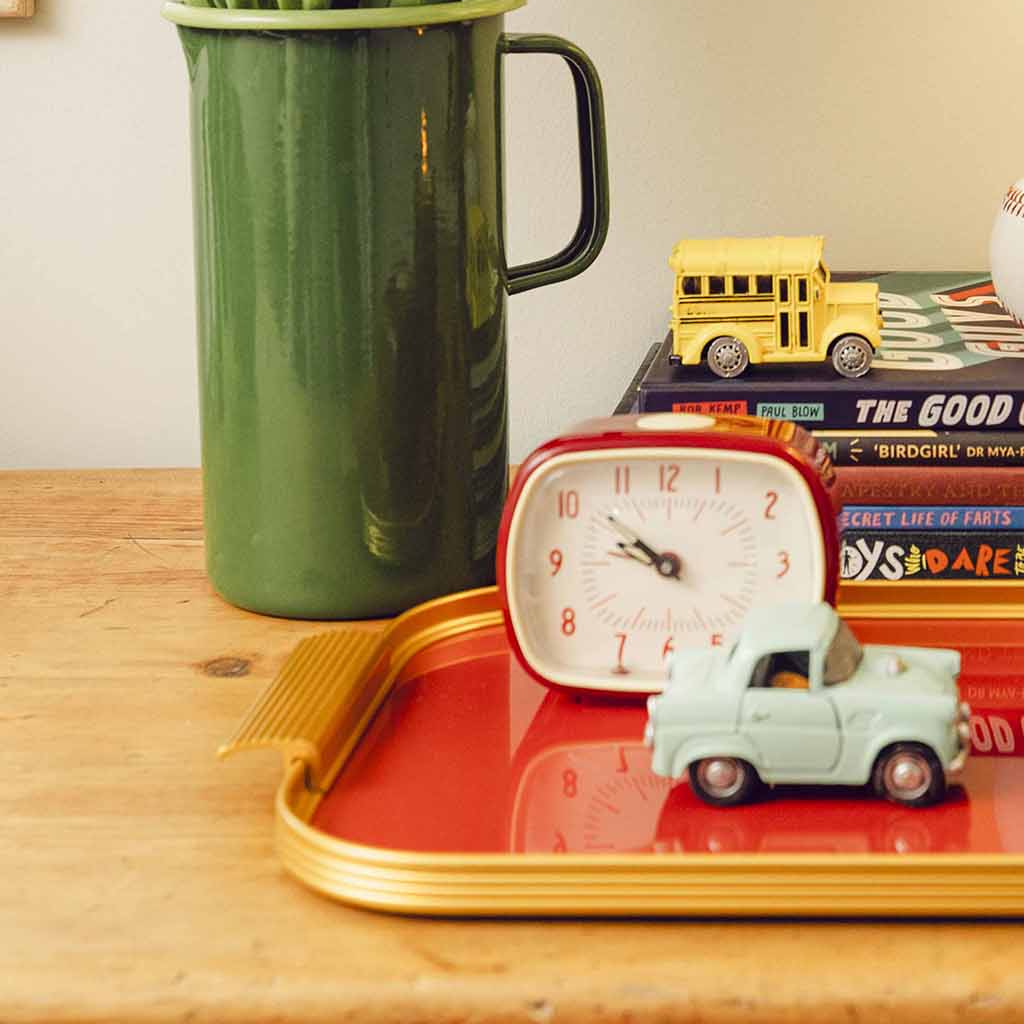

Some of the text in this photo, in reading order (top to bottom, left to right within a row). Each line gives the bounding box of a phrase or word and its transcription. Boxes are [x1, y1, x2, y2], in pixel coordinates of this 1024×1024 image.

[761, 405, 820, 418] PAUL BLOW
[856, 400, 913, 424] THE
[918, 394, 1014, 427] GOOD
[967, 447, 984, 457] DR
[615, 467, 630, 494] 11
[659, 464, 679, 493] 12
[557, 490, 579, 519] 10
[764, 491, 778, 520] 2
[901, 512, 935, 526] LIFE
[940, 512, 959, 526] OF
[965, 511, 1012, 526] FARTS
[549, 549, 563, 576] 9
[776, 551, 790, 577] 3
[925, 544, 1012, 576] DARE
[561, 608, 576, 636] 8
[615, 634, 628, 668] 7
